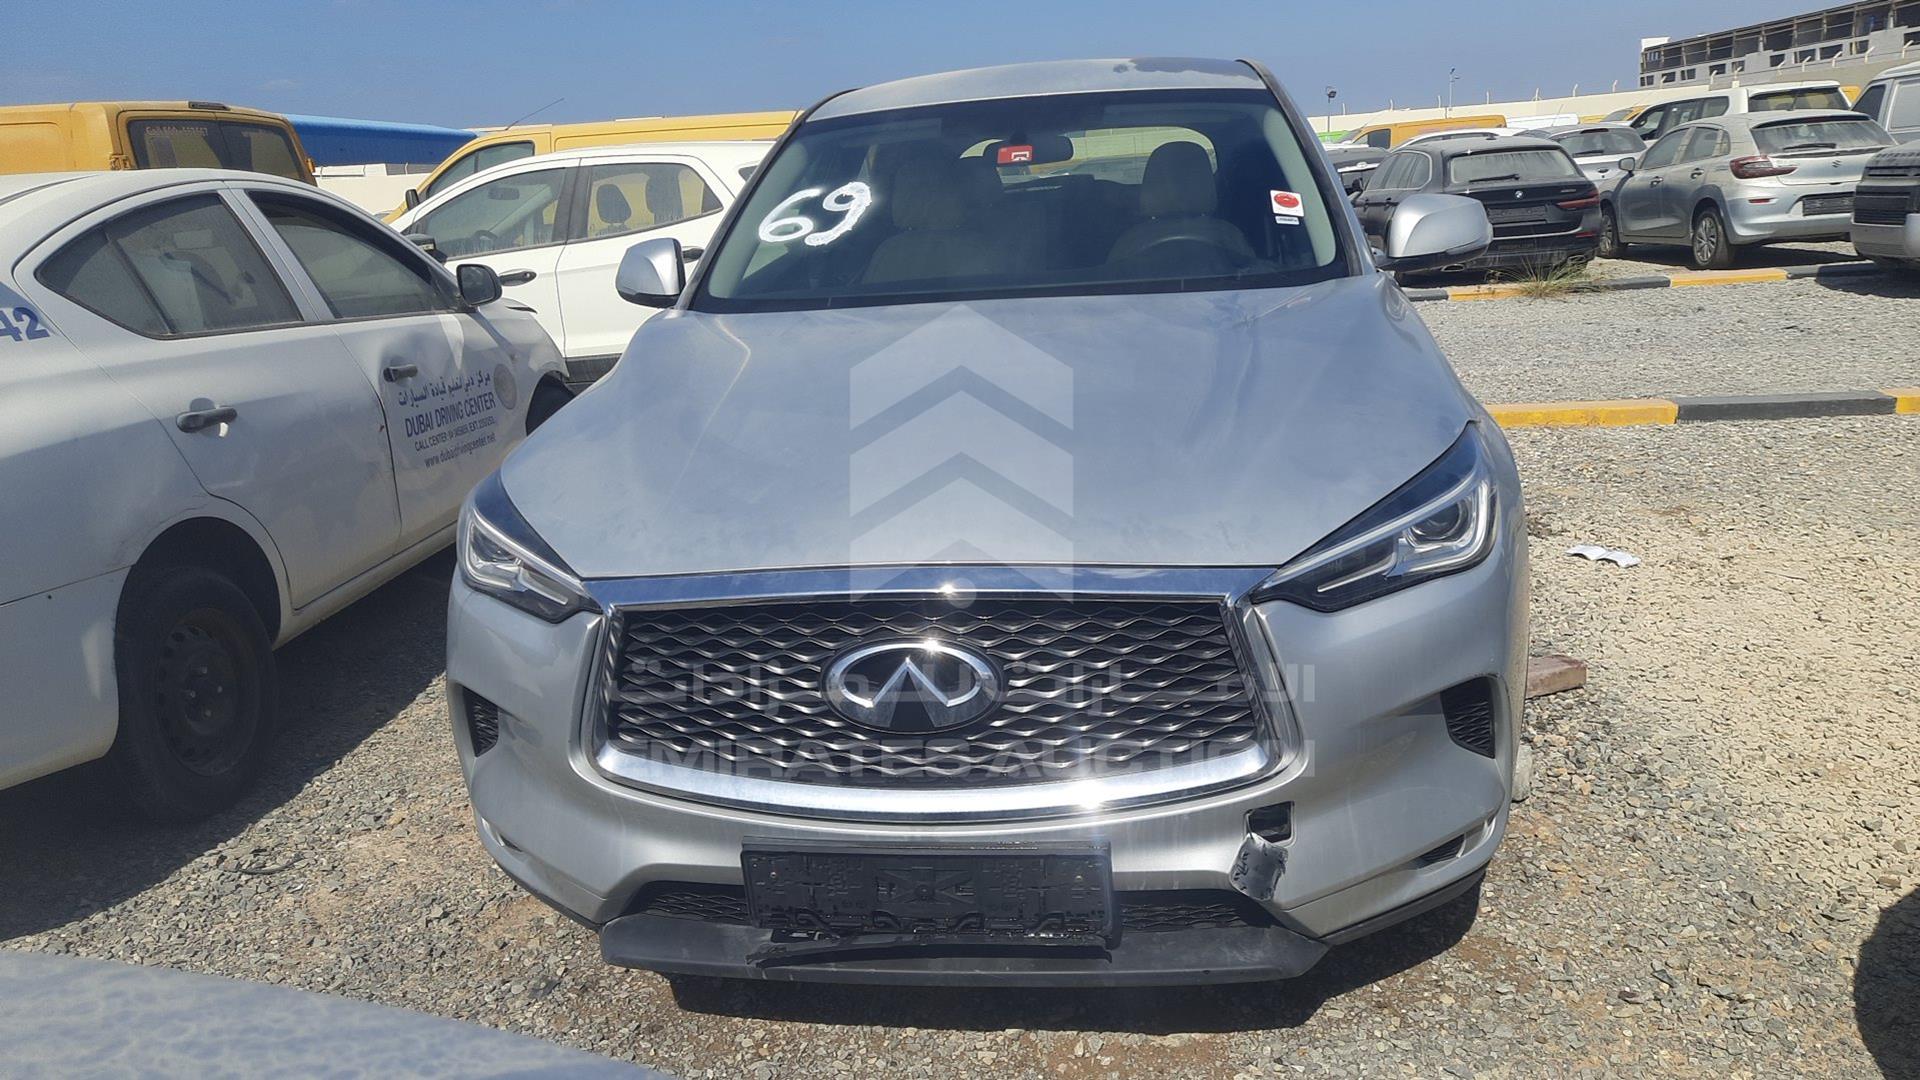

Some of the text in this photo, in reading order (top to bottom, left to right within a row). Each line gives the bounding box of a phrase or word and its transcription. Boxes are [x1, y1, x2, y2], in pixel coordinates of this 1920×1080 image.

[758, 181, 872, 247] 69
[404, 411, 435, 438] DUBAI
[434, 401, 464, 428] DRIVING
[464, 391, 497, 418] CENTER
[414, 438, 429, 452] CALL
